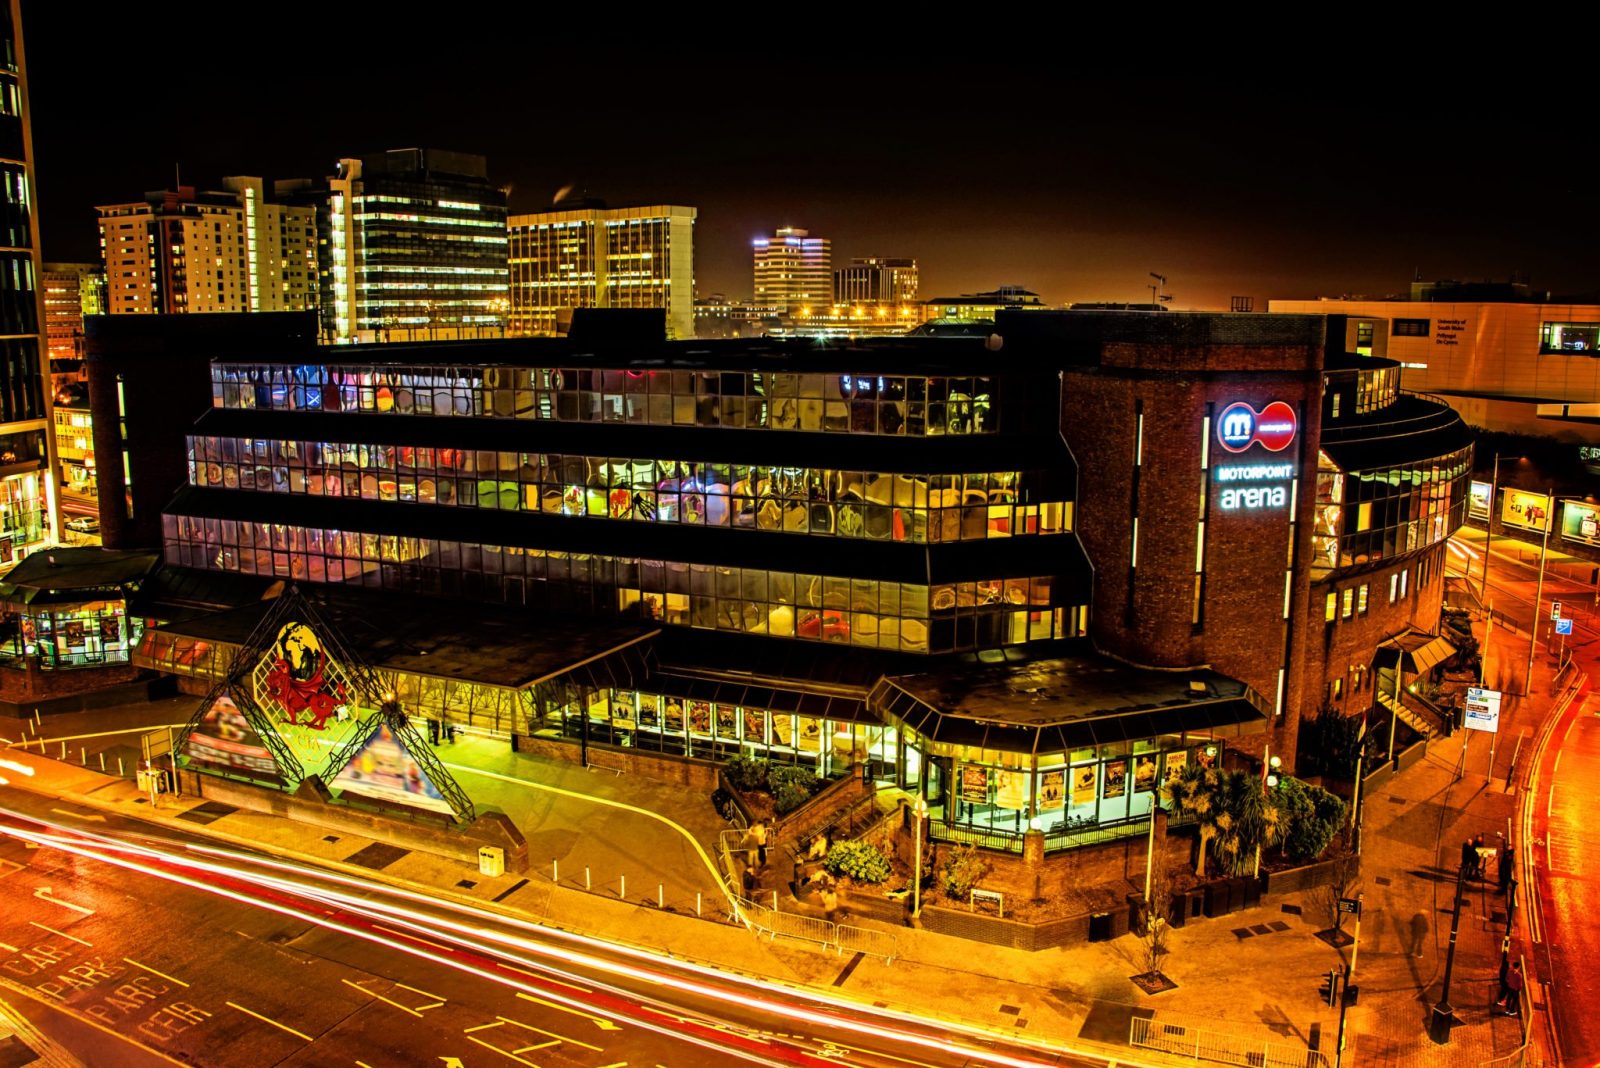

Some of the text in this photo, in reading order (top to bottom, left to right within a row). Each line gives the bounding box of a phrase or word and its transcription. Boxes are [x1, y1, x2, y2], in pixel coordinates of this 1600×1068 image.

[1218, 465, 1293, 481] MOTORPOINT
[1221, 486, 1286, 509] arena
[3, 944, 72, 976] CAR
[85, 976, 169, 1025] PARC
[138, 1001, 212, 1042] CEIR
